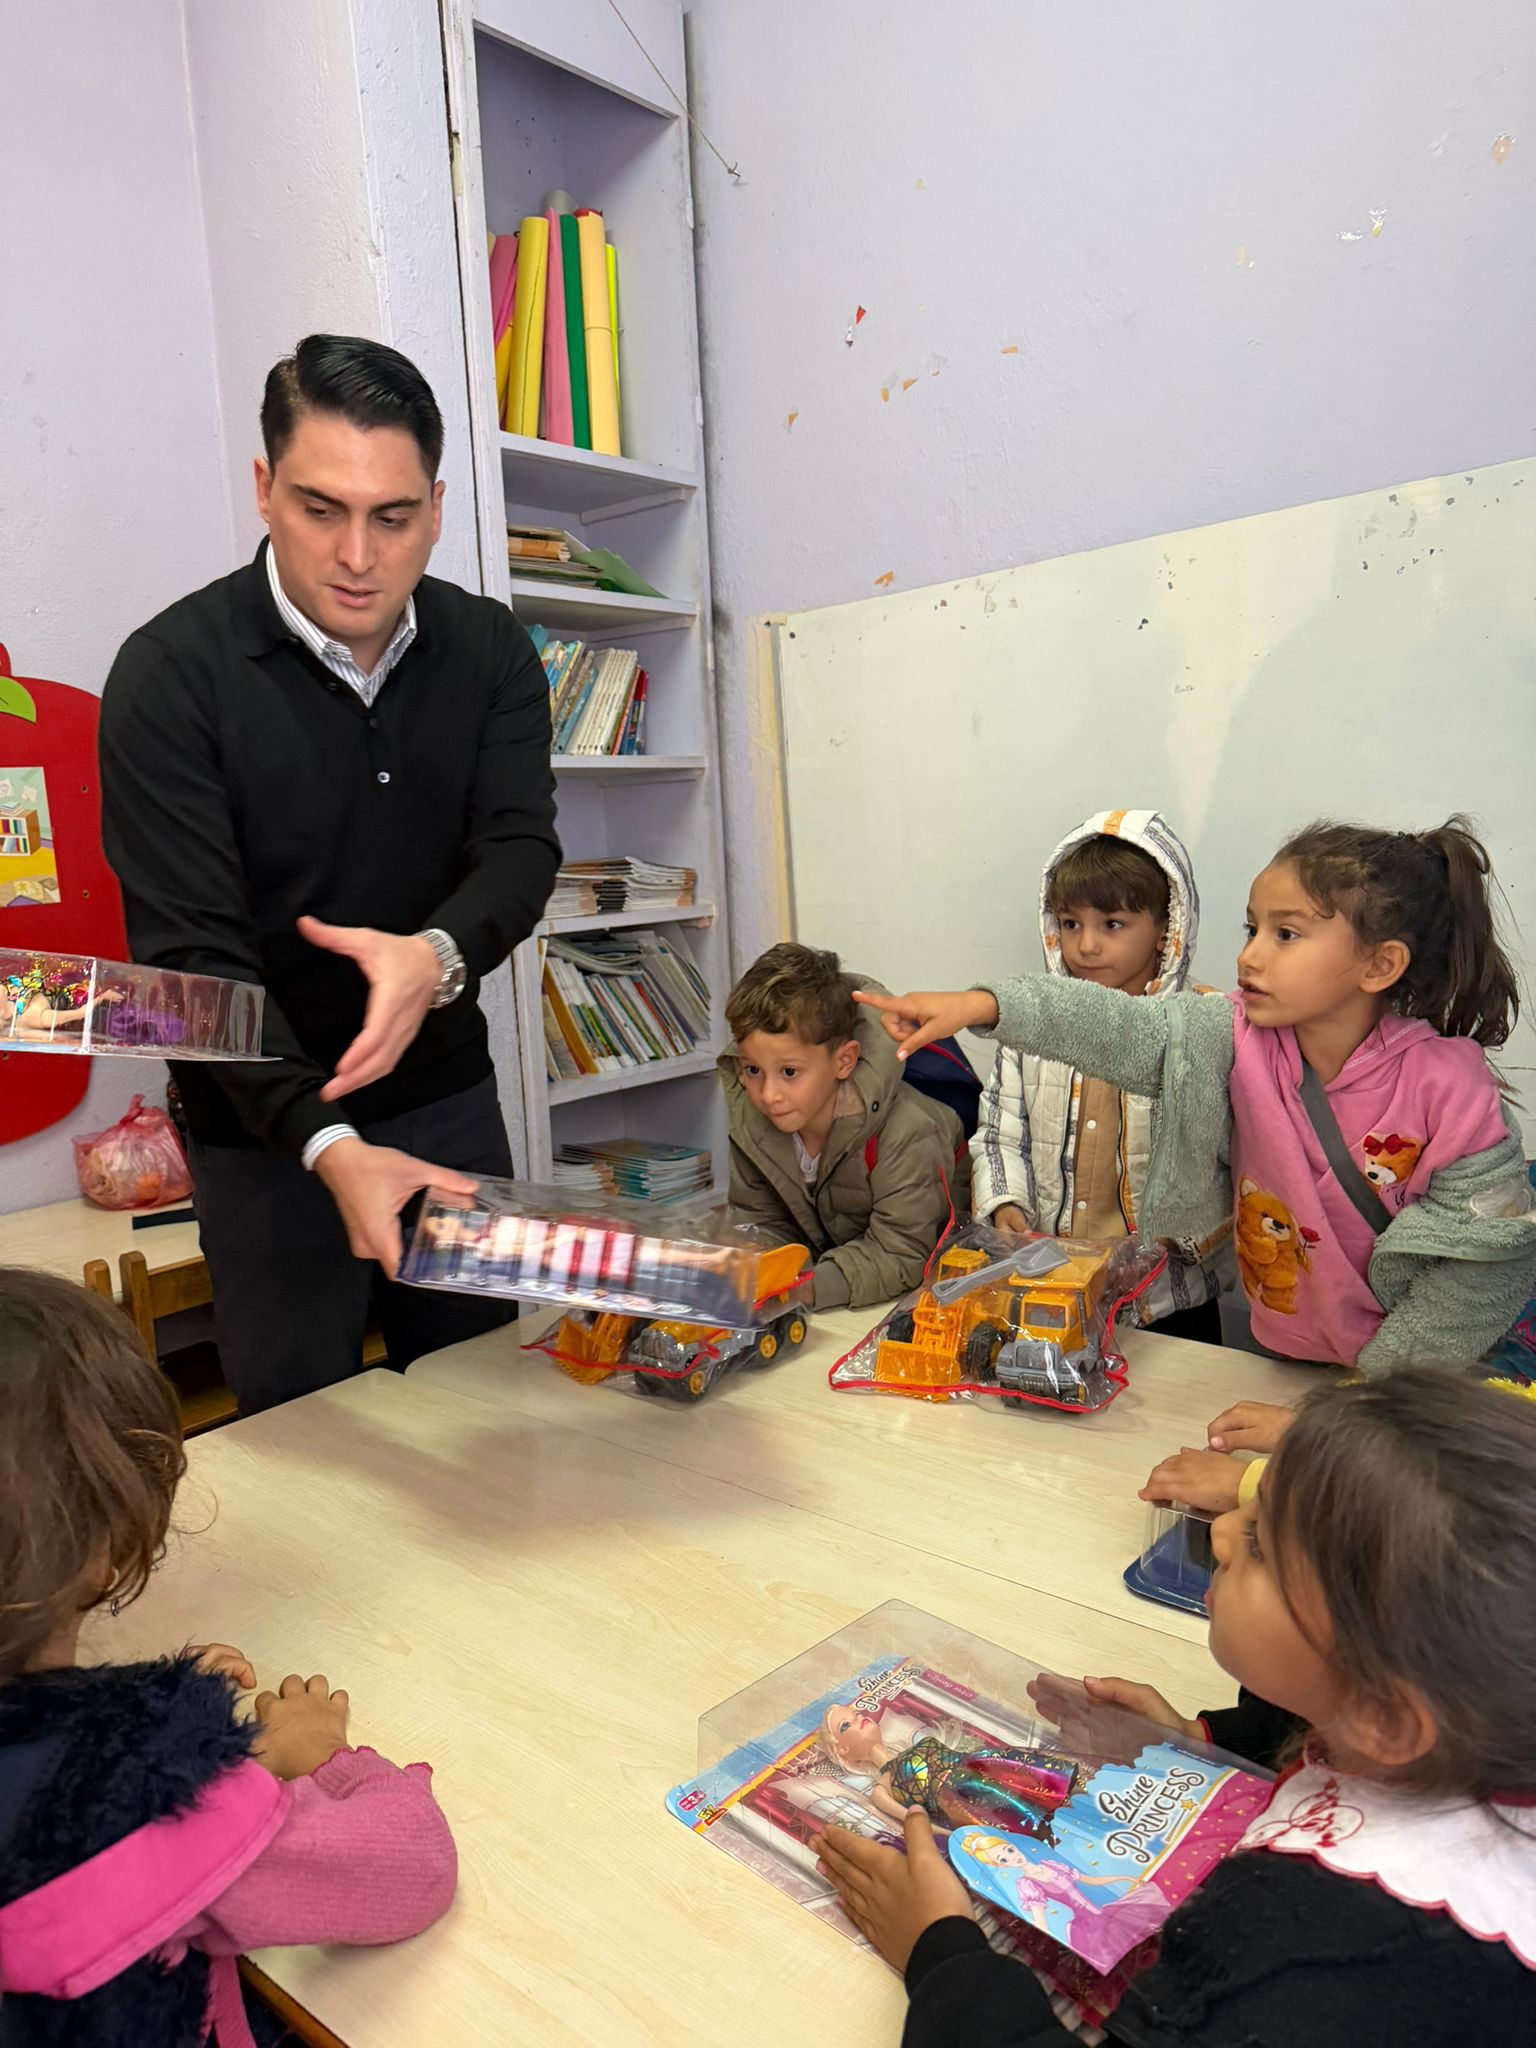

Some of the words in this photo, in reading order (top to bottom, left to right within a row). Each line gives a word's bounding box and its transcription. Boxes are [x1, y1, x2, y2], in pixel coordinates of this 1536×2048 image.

[855, 1666, 921, 1711] PRINCESS
[1099, 1775, 1155, 1823] Shine
[1107, 1767, 1205, 1863] PRINCESS
